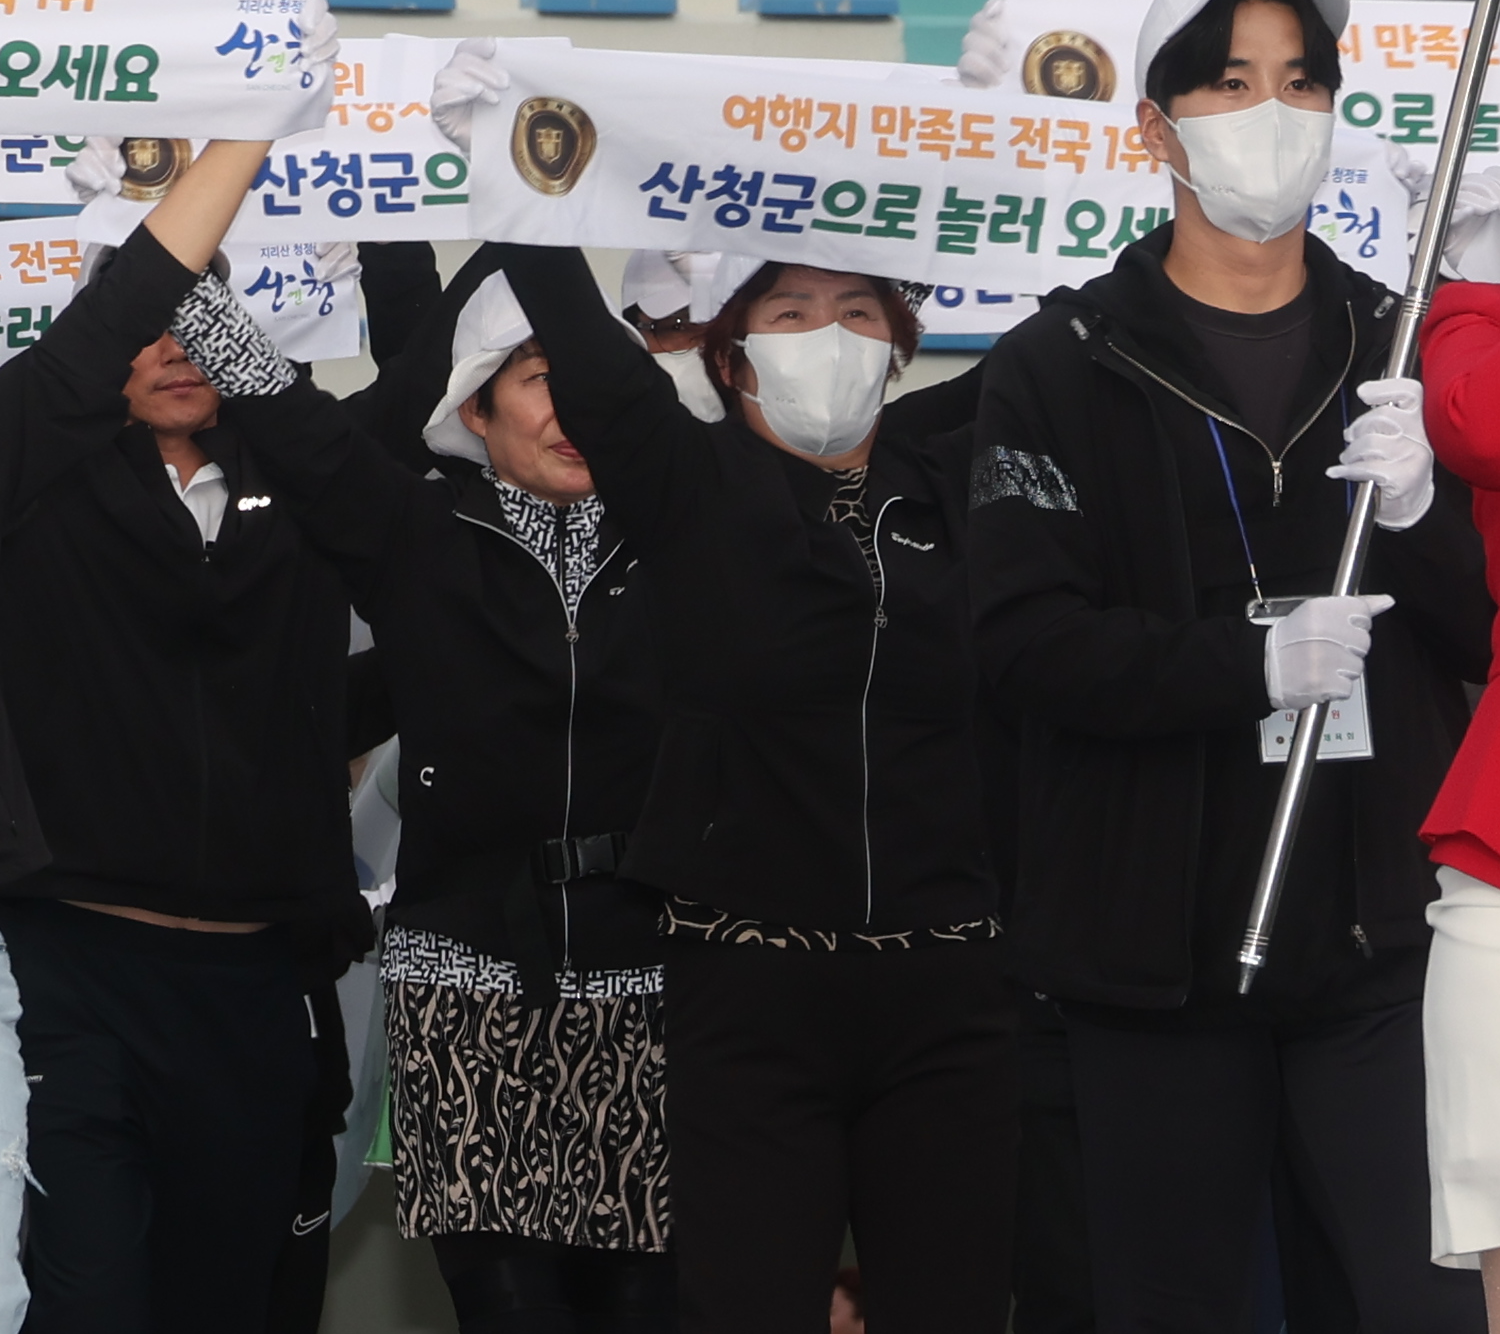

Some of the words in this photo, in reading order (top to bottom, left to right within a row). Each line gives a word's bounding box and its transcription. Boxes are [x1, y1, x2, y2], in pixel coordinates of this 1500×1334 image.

[722, 93, 858, 154] 여행지
[869, 104, 996, 161] 만족도
[1007, 121, 1090, 173] 전국
[638, 160, 923, 241] 산청군으로
[936, 184, 1046, 255] 놀러
[260, 245, 290, 259] 지리산
